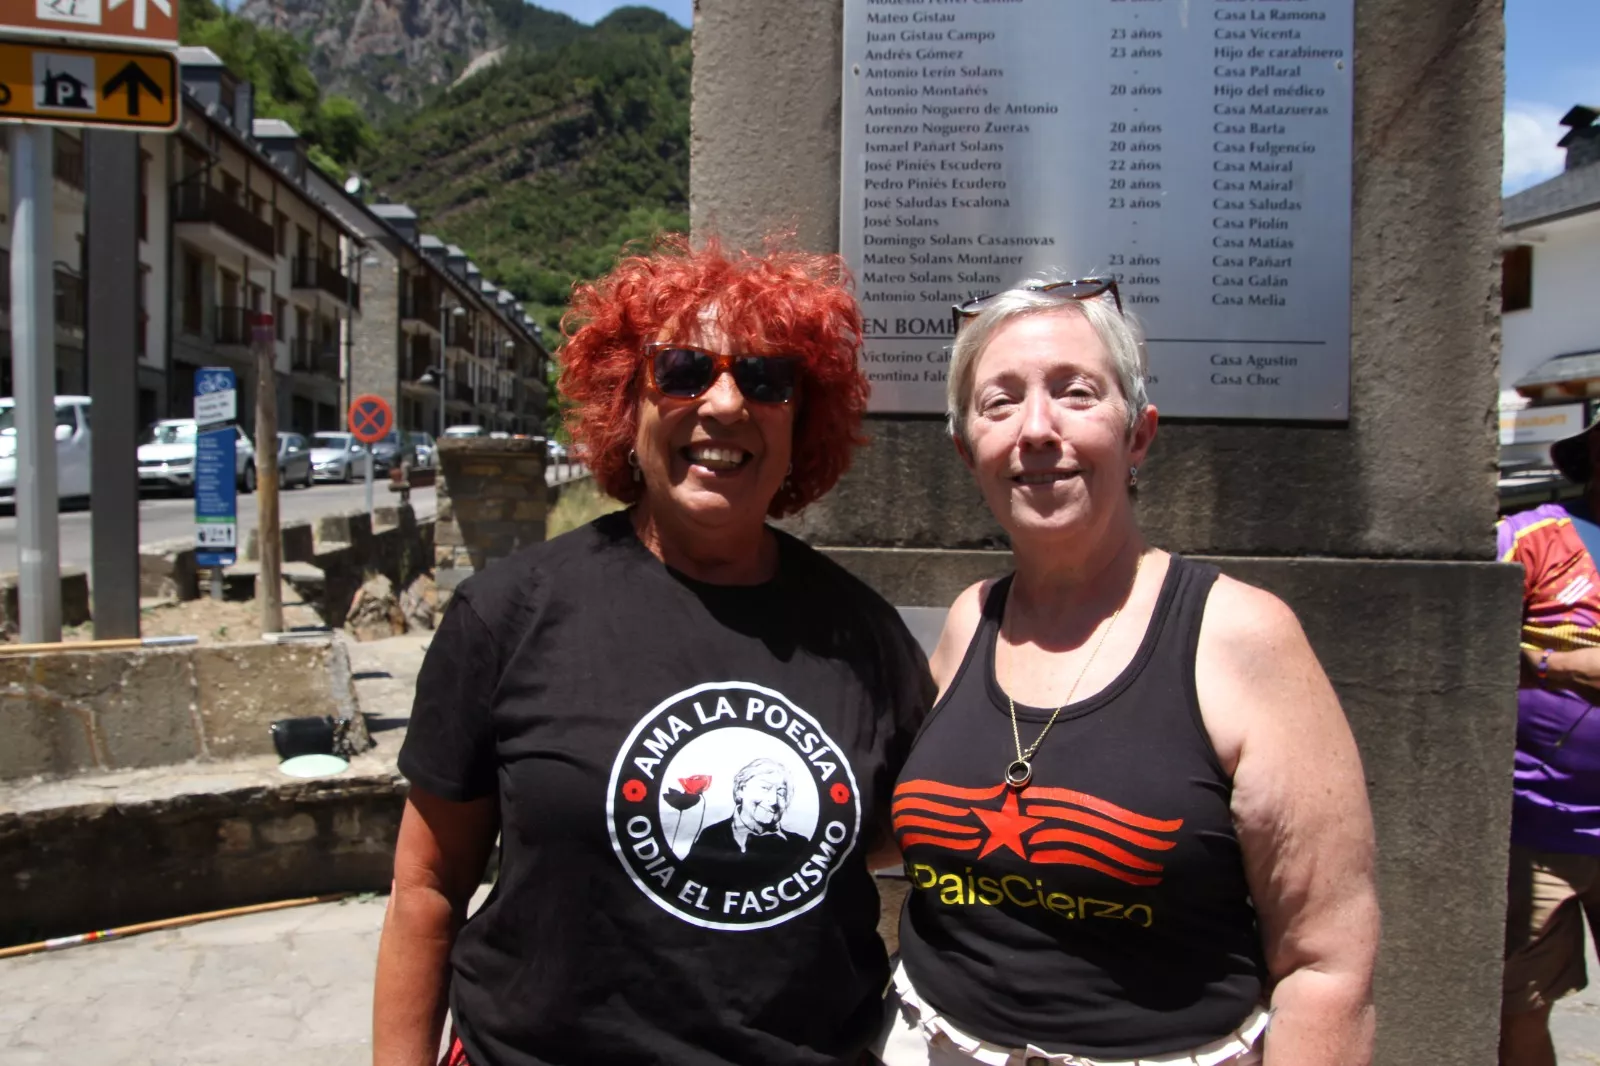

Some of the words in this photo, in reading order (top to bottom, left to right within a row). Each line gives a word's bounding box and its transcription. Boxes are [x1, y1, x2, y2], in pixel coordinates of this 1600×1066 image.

[867, 12, 909, 24] Mateo
[912, 11, 955, 23] Gistau
[1214, 9, 1246, 21] Casa
[1251, 9, 1265, 21] La
[1270, 9, 1326, 21] Ramona
[867, 31, 896, 44] Juan
[900, 30, 943, 42] Gistau
[947, 29, 995, 44] Campo
[1111, 29, 1126, 39] 23
[1131, 28, 1162, 39] años
[1214, 28, 1246, 39] Casa
[1250, 28, 1301, 39] Vicenta
[865, 49, 912, 61] Andrés
[916, 49, 963, 61] Gómez
[1111, 47, 1126, 58] 23
[1131, 46, 1162, 58] años
[1214, 46, 1243, 61] Hijo
[1247, 46, 1265, 58] de
[1269, 46, 1343, 58] carabinero
[865, 67, 918, 79] Antonio
[960, 66, 1003, 77] Solans
[1213, 65, 1246, 77] Casa
[1250, 65, 1301, 77] Pallaral
[865, 86, 918, 97] Antonio
[922, 85, 988, 96] Montañés
[1111, 85, 1126, 95] 20
[1131, 84, 1162, 95] años
[1214, 84, 1243, 99] Hijo
[1247, 84, 1269, 96] del
[1273, 84, 1325, 97] médico
[865, 104, 918, 116] Antonio
[922, 104, 980, 119] Noguero
[984, 103, 1000, 115] de
[1005, 103, 1058, 114] Antonio
[1213, 104, 1245, 115] Casa
[865, 123, 918, 134] Lorenzo
[923, 122, 980, 137] Noguero
[985, 122, 1029, 133] Zueras
[1110, 122, 1126, 133] 20
[1130, 122, 1162, 133] años
[1213, 122, 1245, 134] Casa
[865, 140, 908, 152] Ismael
[960, 140, 1004, 152] Solans
[1110, 141, 1126, 152] 20
[1130, 141, 1161, 152] años
[1213, 141, 1245, 153] Casa
[865, 159, 892, 173] José
[940, 158, 1001, 171] Escudero
[1109, 159, 1125, 171] 22
[1130, 159, 1161, 171] años
[1213, 160, 1245, 172] Casa
[1249, 160, 1293, 172] Mairal
[865, 178, 903, 190] Pedro
[1110, 179, 1126, 190] 20
[1130, 179, 1161, 190] años
[1213, 179, 1244, 191] Casa
[1249, 179, 1293, 191] Mairal
[864, 197, 891, 210] José
[896, 196, 947, 209] Saludas
[952, 196, 1010, 208] Escalona
[1109, 197, 1125, 208] 23
[1129, 197, 1161, 209] años
[1212, 198, 1244, 210] Casa
[1249, 198, 1301, 210] Saludas
[864, 215, 891, 229] José
[896, 215, 939, 227] Solans
[1212, 217, 1244, 229] Casa
[864, 234, 925, 249] Domingo
[930, 234, 973, 245] Solans
[977, 234, 1055, 246] Casasnovas
[1213, 236, 1244, 248] Casa
[863, 253, 906, 264] Mateo
[910, 252, 953, 264] Solans
[957, 253, 1023, 264] Montaner
[1108, 254, 1124, 266] 23
[1129, 254, 1160, 265] años
[1212, 255, 1243, 267] Casa
[863, 272, 905, 283] Mateo
[909, 271, 953, 283] Solans
[957, 271, 1001, 283] Solans
[1129, 272, 1160, 285] años
[1212, 275, 1243, 286] Casa
[1248, 275, 1288, 287] Galán
[863, 291, 916, 302] Antonio
[919, 290, 963, 302] Solans
[1129, 291, 1160, 303] años
[1212, 294, 1243, 305] Casa
[862, 318, 888, 335] EN
[862, 352, 922, 363] Victorino
[1210, 354, 1242, 366] Casa
[868, 370, 919, 382] eontina
[1210, 373, 1242, 385] Casa
[1246, 373, 1279, 385] Choc
[634, 714, 694, 780] AMA
[693, 696, 737, 725] LA
[745, 697, 838, 782] POESÍA
[626, 815, 677, 888] ODIA
[677, 879, 711, 911] EL
[722, 820, 848, 915] FASCISMO
